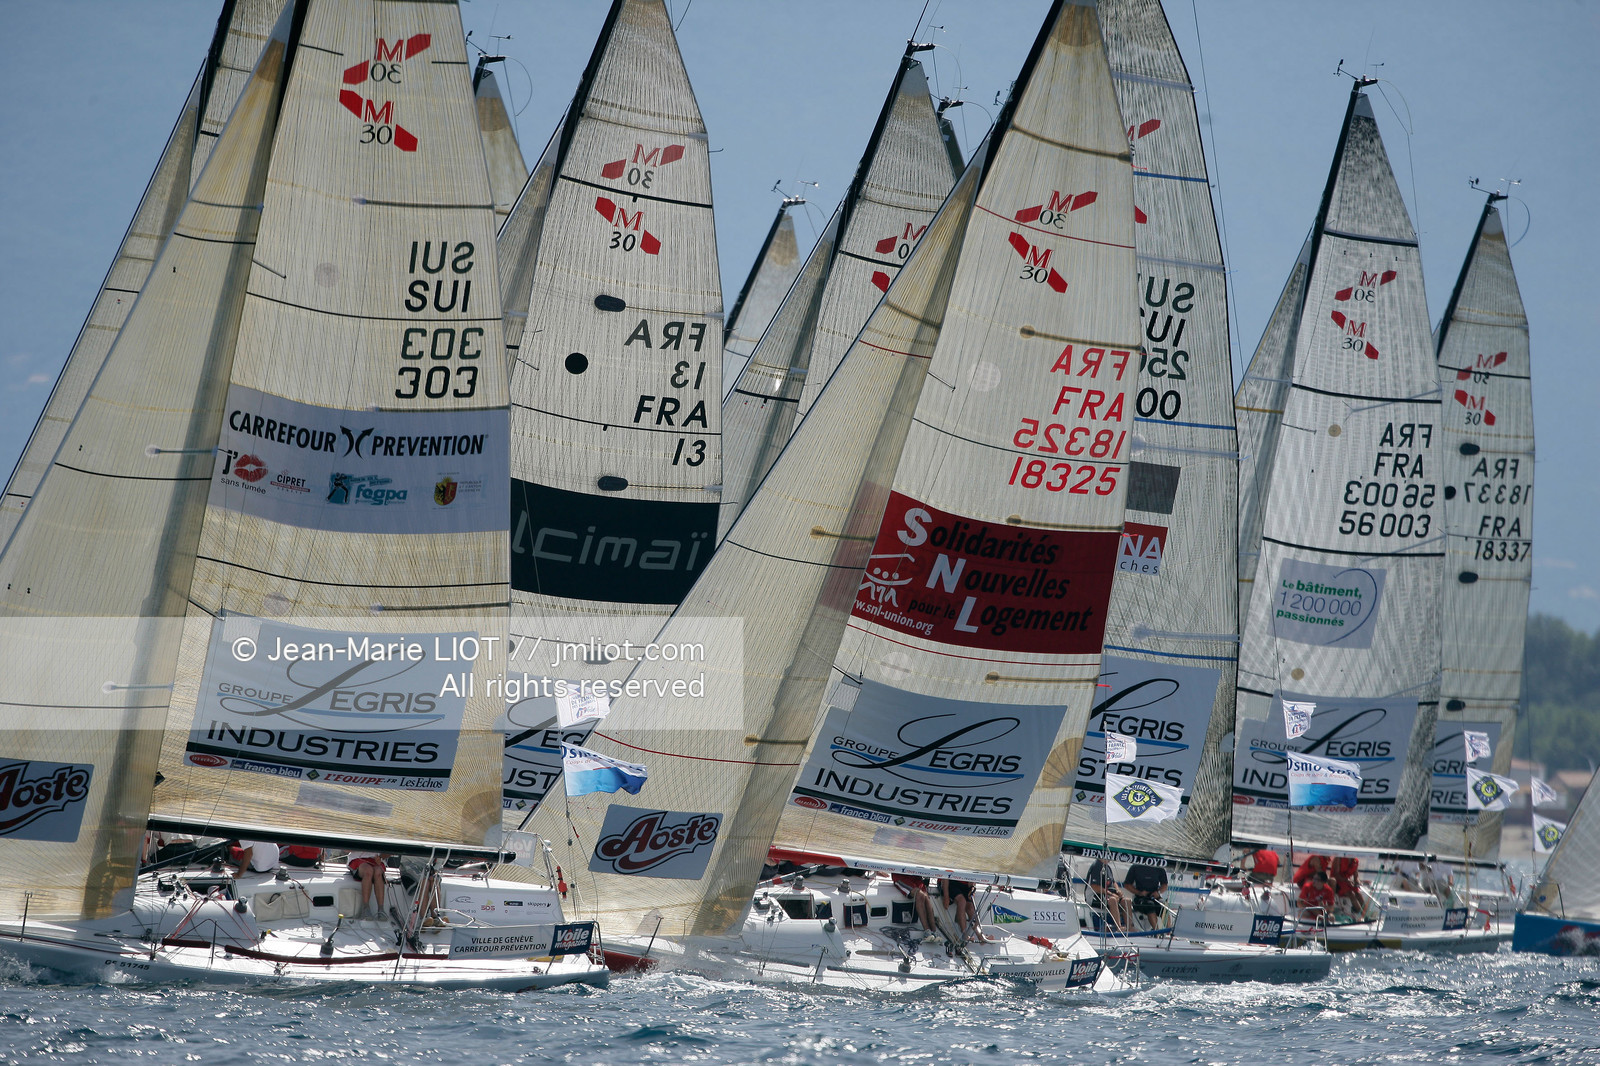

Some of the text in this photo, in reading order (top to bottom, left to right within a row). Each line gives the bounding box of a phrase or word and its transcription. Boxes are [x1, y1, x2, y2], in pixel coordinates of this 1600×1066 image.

[364, 98, 395, 124] M
[359, 124, 393, 146] 30
[613, 207, 644, 231] M
[609, 231, 636, 252] 30
[1025, 245, 1054, 268] M
[1019, 265, 1049, 284] 30
[404, 280, 471, 313] SUI
[1346, 319, 1367, 338] M
[1342, 337, 1364, 352] 30
[394, 366, 478, 399] 303
[633, 394, 708, 428] FRA
[1052, 385, 1125, 422] FRA
[1467, 395, 1485, 410] M
[1464, 411, 1481, 425] 30
[228, 410, 486, 457] CARREFOUR PREVENTION
[671, 438, 707, 466] 13
[1008, 456, 1121, 496] 18325
[1373, 452, 1424, 478] FRA
[220, 477, 240, 487] sans
[241, 481, 267, 495] fumée
[276, 474, 306, 488] CIPRET
[1338, 510, 1431, 538] 56003
[1478, 515, 1521, 538] FRA
[896, 507, 1060, 565] Solidarités
[1474, 540, 1531, 562] 18337
[925, 552, 1071, 600] Nouvelles
[1282, 579, 1295, 590] Le
[907, 596, 1093, 636] pour le Logement
[1275, 609, 1346, 627] passionnés
[217, 682, 293, 704] GROUPE
[219, 647, 445, 733] LEGRIS
[206, 719, 440, 764] INDUSTRIES
[831, 713, 1023, 789] LEGRIS
[832, 735, 899, 760] GROUPE
[243, 762, 301, 777] france bleu
[814, 767, 1014, 815] INDUSTRIES
[840, 806, 890, 824] france bleu
[600, 814, 716, 860] Aoste
[1081, 848, 1168, 868] HENRI LLOYD
[1033, 910, 1066, 922] ESSEC
[1194, 921, 1234, 932] BIENNE-VOILE
[1255, 919, 1281, 932] Voile
[504, 935, 534, 943] GENÈVE
[554, 939, 588, 950] magazine
[556, 927, 590, 943] Voile
[454, 943, 547, 953] CARREFOUR PRÉVENTION
[1031, 968, 1066, 977] NOUVELLES
[1073, 961, 1099, 975] Voile
